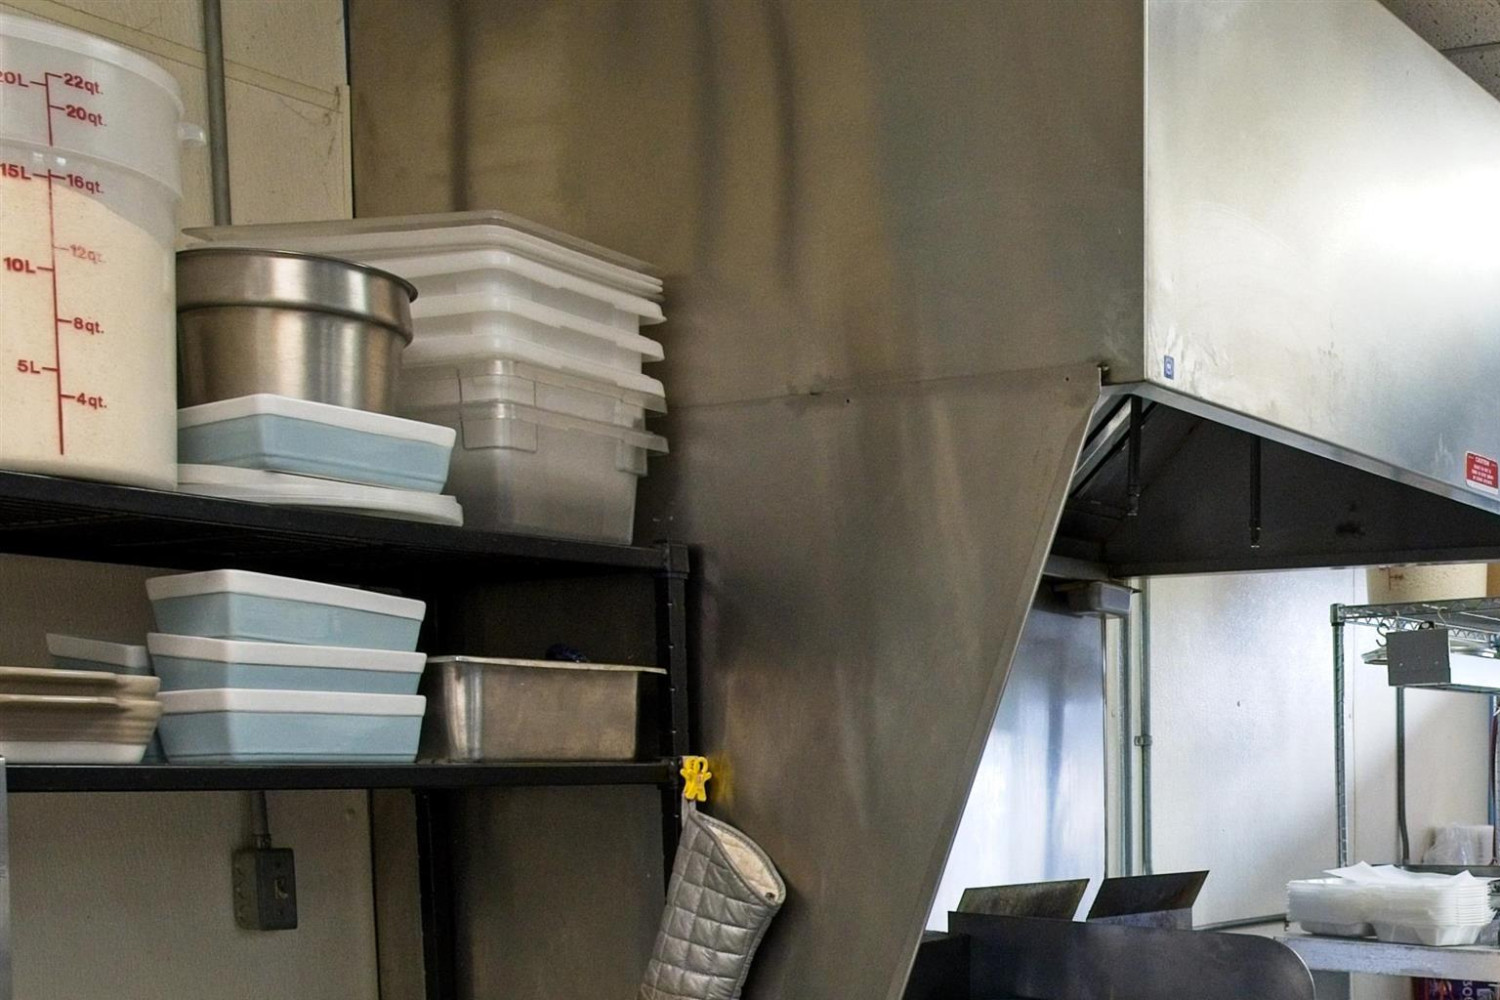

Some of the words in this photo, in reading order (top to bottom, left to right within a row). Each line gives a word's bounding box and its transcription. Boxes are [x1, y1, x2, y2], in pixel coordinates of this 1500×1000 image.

[63, 73, 103, 95] 22qt.
[66, 104, 107, 126] 20qt.
[0, 163, 31, 180] 15L
[67, 174, 104, 194] 16qt.
[69, 244, 106, 264] 12qt.
[3, 257, 36, 274] 10L
[73, 317, 104, 335] 8qt.
[17, 359, 41, 374] 5L
[76, 392, 107, 410] 4qt.
